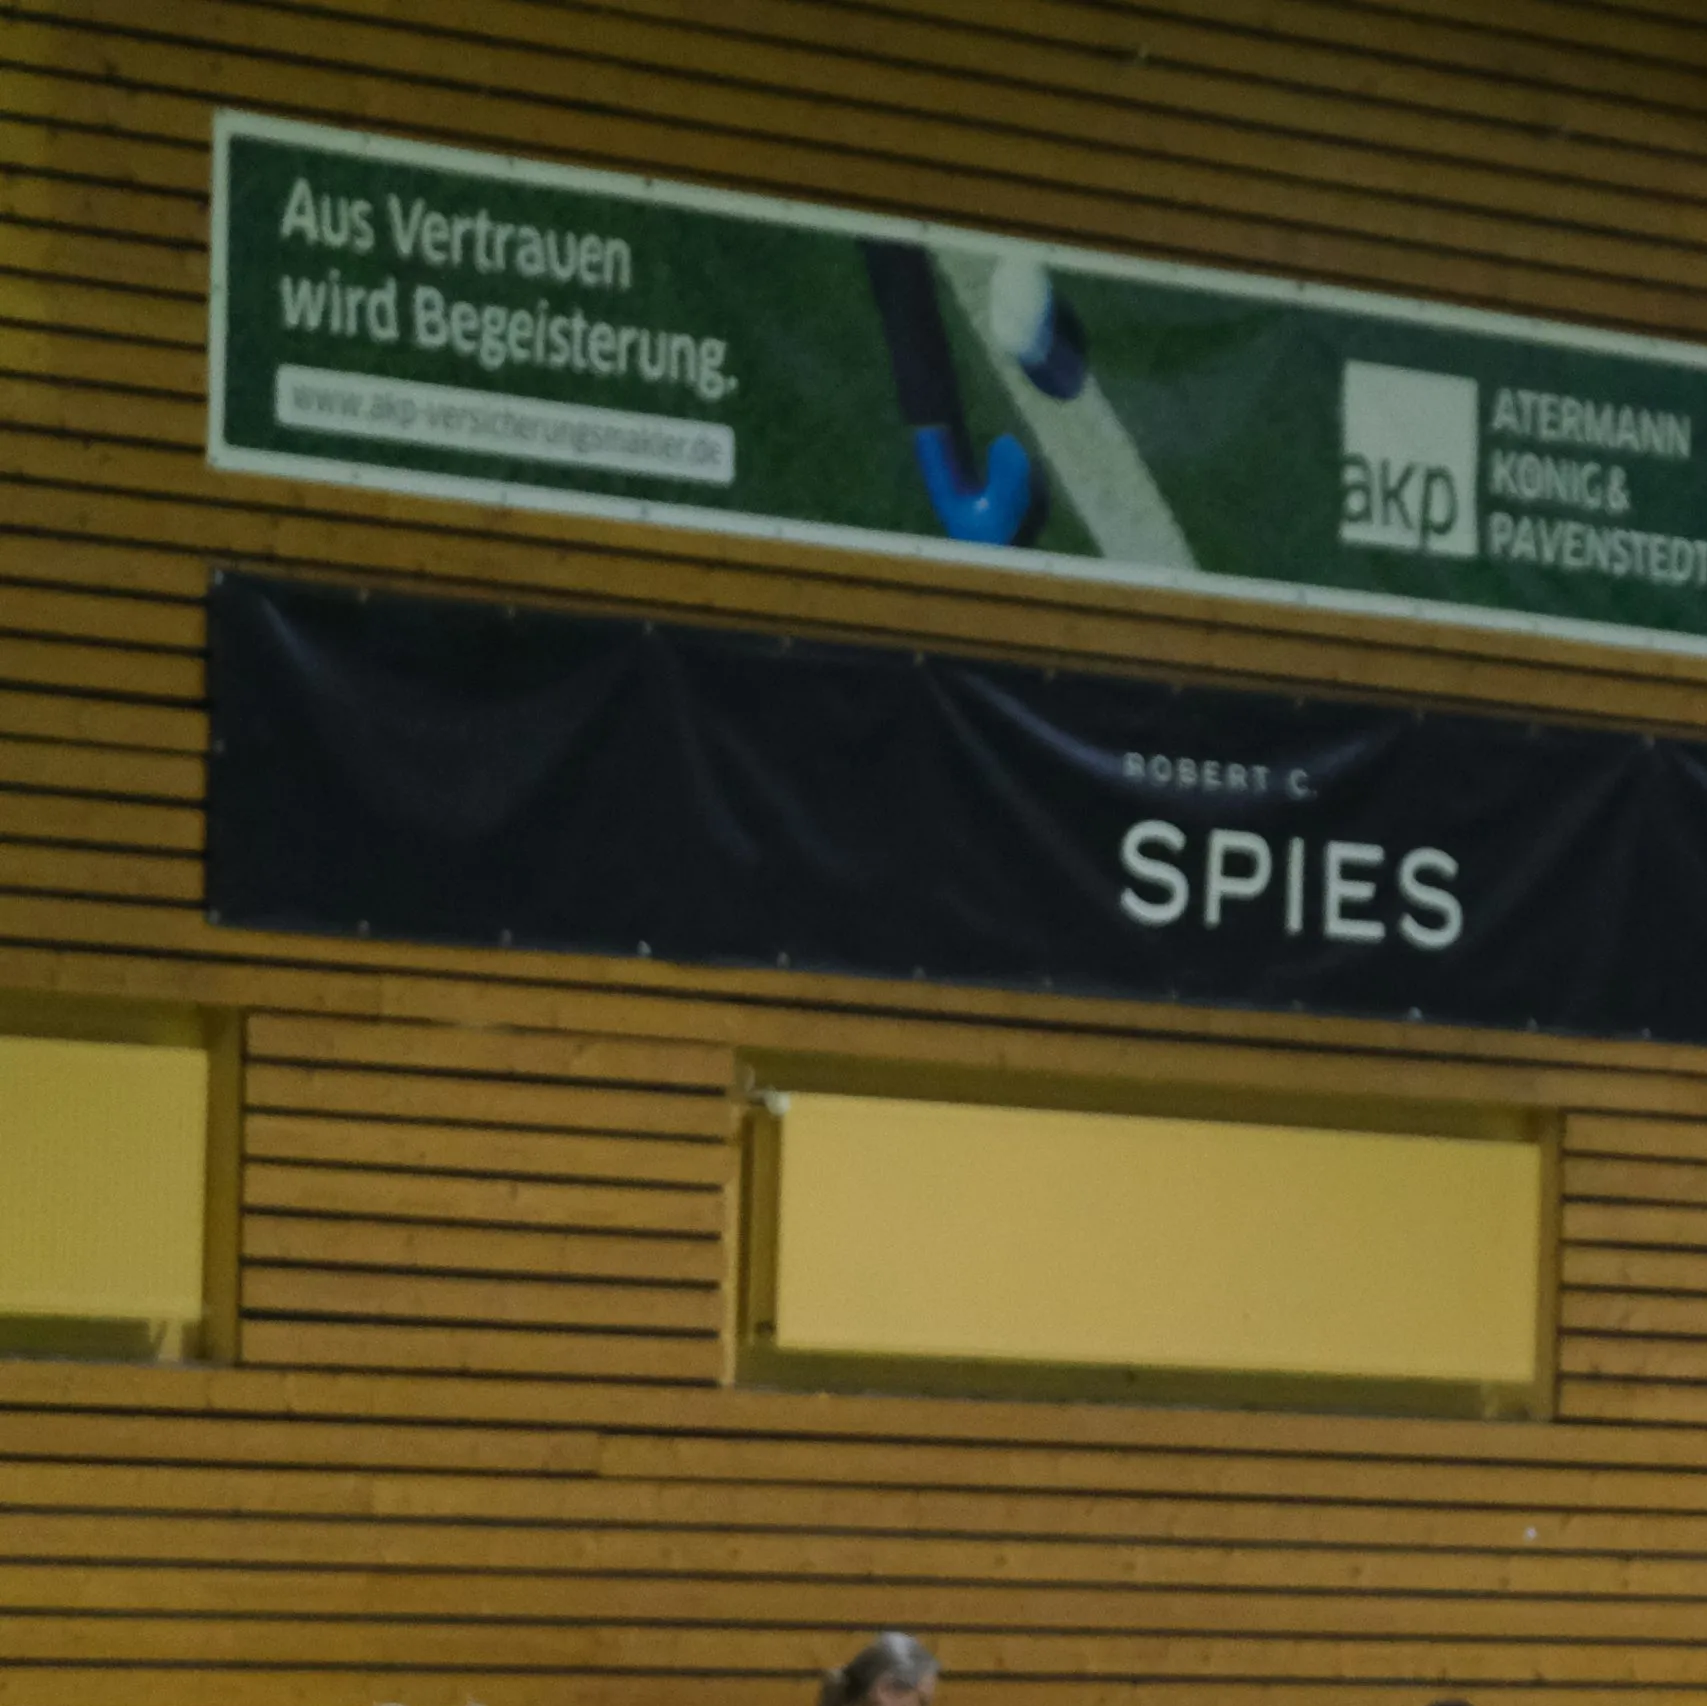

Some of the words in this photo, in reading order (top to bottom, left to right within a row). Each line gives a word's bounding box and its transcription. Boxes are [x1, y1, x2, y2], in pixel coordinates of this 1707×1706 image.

[281, 177, 374, 254] Aus
[387, 194, 633, 291] Vertrauen
[280, 269, 398, 345] wird
[413, 285, 739, 399] Begeisterung.
[1491, 387, 1692, 460] ATERMANN
[1341, 454, 1457, 549] akp
[1604, 464, 1632, 515] &
[1122, 751, 1271, 794] ROBERT
[1287, 768, 1318, 798] C.
[1120, 819, 1463, 950] SPIES
